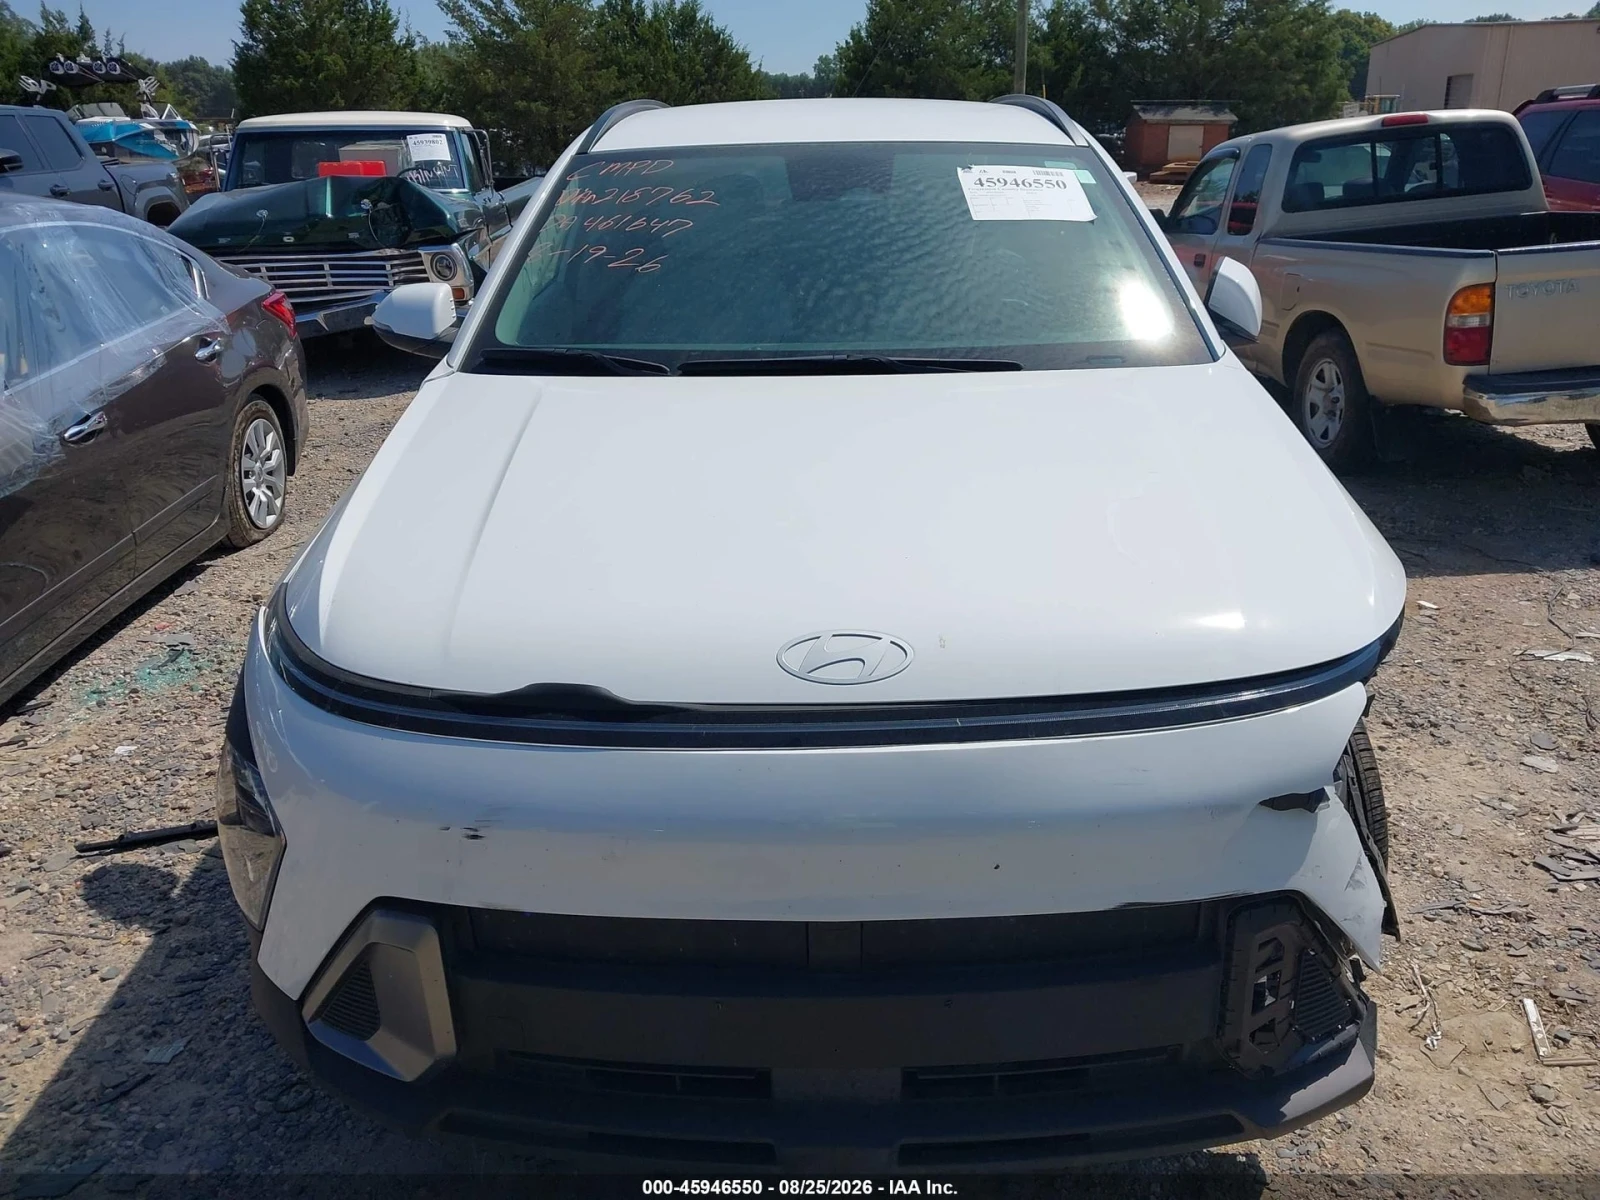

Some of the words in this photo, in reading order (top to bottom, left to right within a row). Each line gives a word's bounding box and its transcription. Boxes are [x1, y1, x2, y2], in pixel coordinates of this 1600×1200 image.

[567, 160, 674, 181] CMPD
[974, 177, 1067, 189] 45946550
[1505, 278, 1580, 300] TOYOTA
